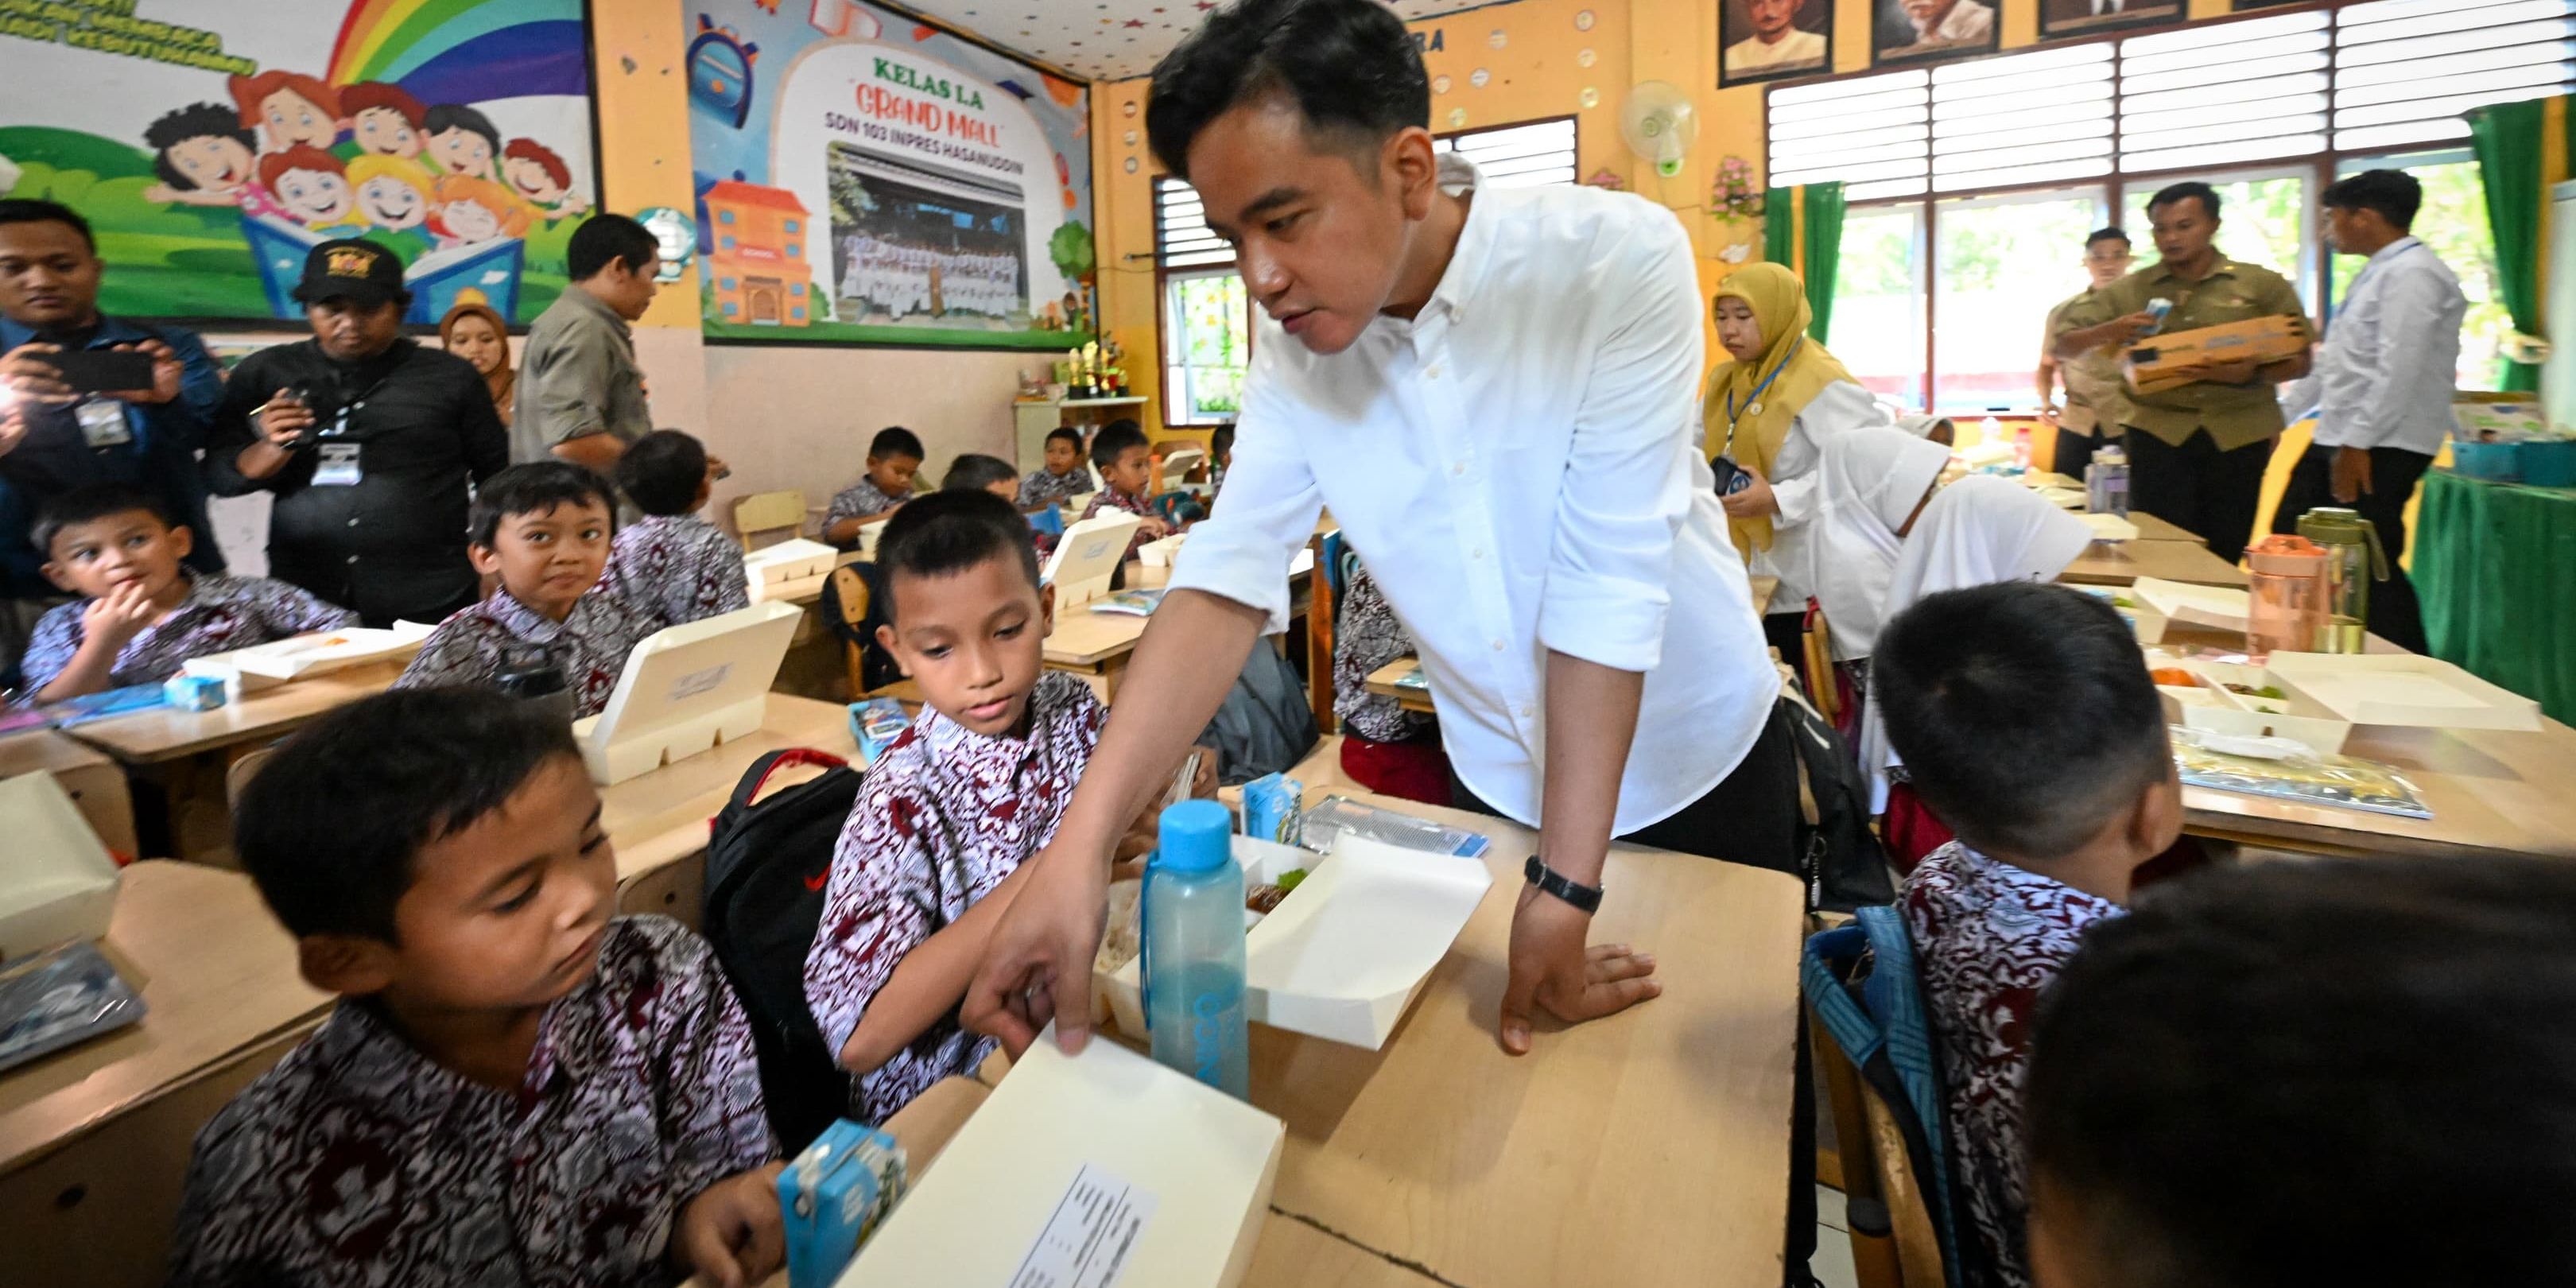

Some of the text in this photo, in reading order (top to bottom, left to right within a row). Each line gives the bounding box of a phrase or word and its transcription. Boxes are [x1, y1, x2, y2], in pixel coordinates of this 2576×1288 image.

[874, 58, 951, 99] KELAS
[825, 112, 1024, 176] SDN 103 INPRES HASANUDDIN
